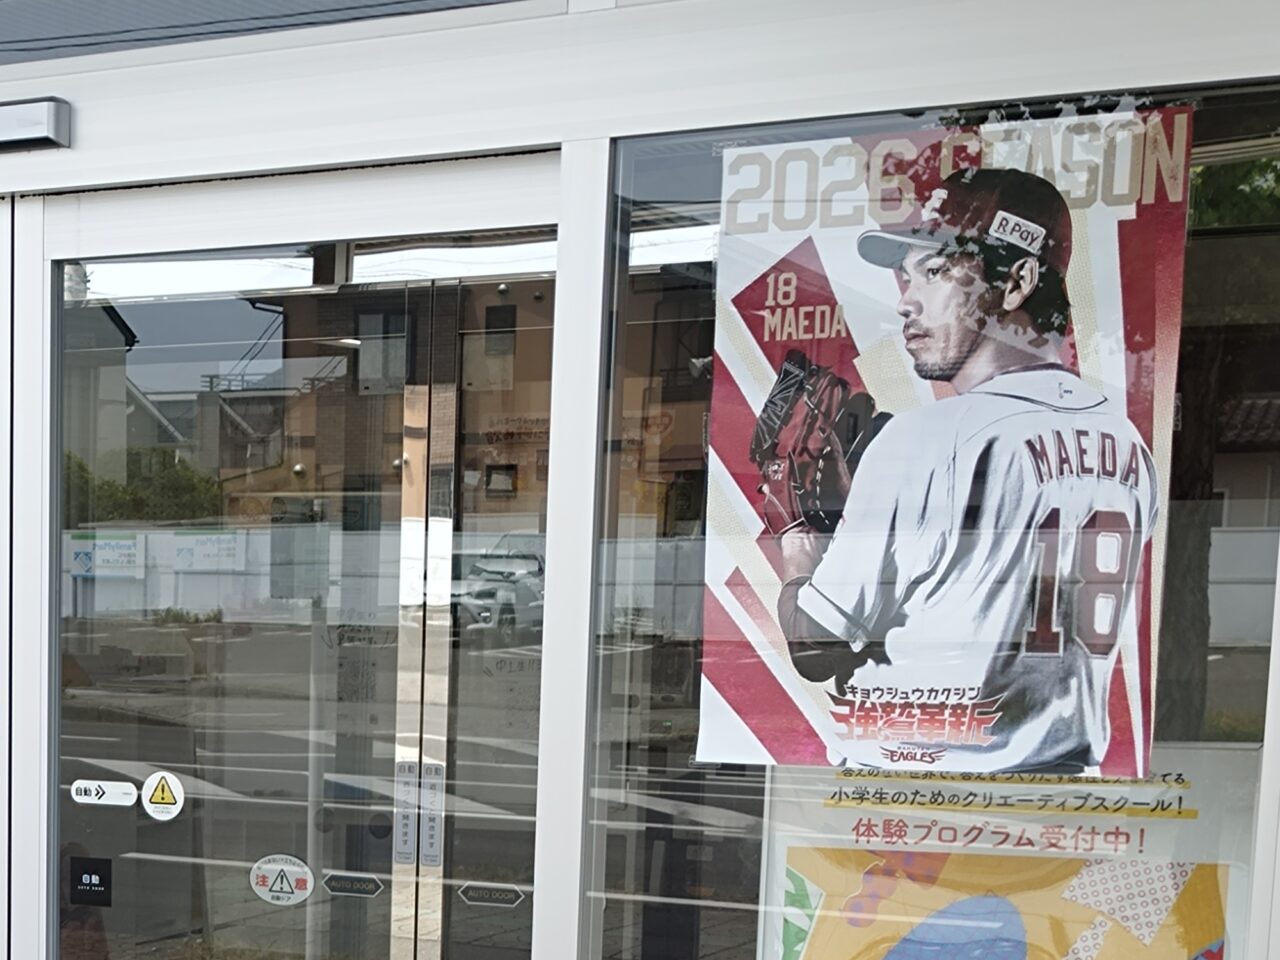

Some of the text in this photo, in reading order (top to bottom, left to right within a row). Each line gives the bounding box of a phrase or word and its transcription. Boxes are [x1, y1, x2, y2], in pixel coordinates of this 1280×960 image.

[725, 138, 917, 235] 2026
[1009, 221, 1039, 247] Pay
[765, 272, 797, 306] 18
[764, 304, 847, 341] MAEDA
[1024, 428, 1139, 488] MAEDA
[1023, 507, 1132, 659] 18
[846, 684, 981, 701] キョウシュウカクシン
[888, 749, 940, 764] EAGLES
[76, 787, 92, 797] 自動
[82, 874, 99, 884] 自動
[330, 880, 351, 888] AUTO
